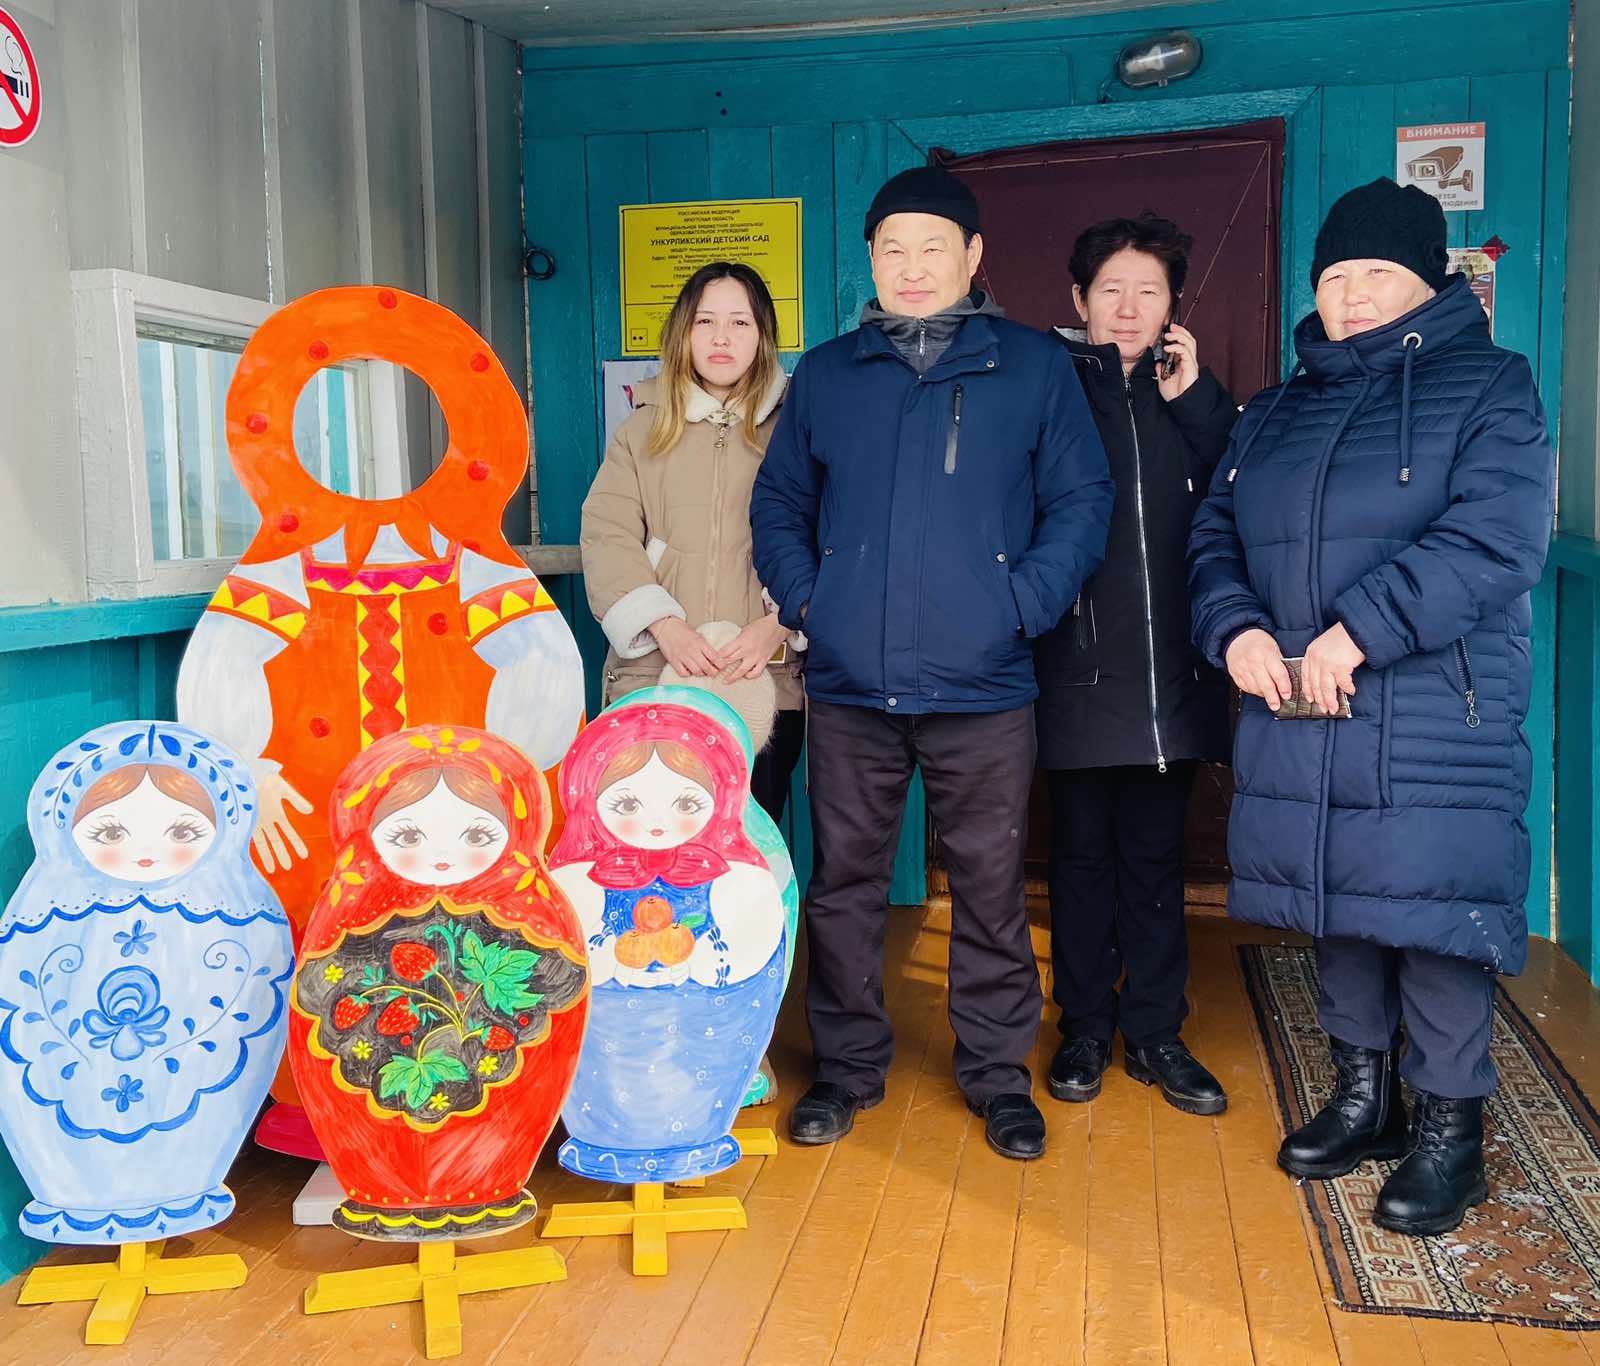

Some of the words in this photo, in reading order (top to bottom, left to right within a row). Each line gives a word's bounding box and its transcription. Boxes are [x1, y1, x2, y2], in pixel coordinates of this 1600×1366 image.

[1406, 125, 1477, 138] ВНИМАНИЕ
[650, 236, 712, 246] УНКУРЛИКСКИЙ
[713, 235, 751, 244] ДЕТСКИЙ
[752, 234, 770, 242] САД
